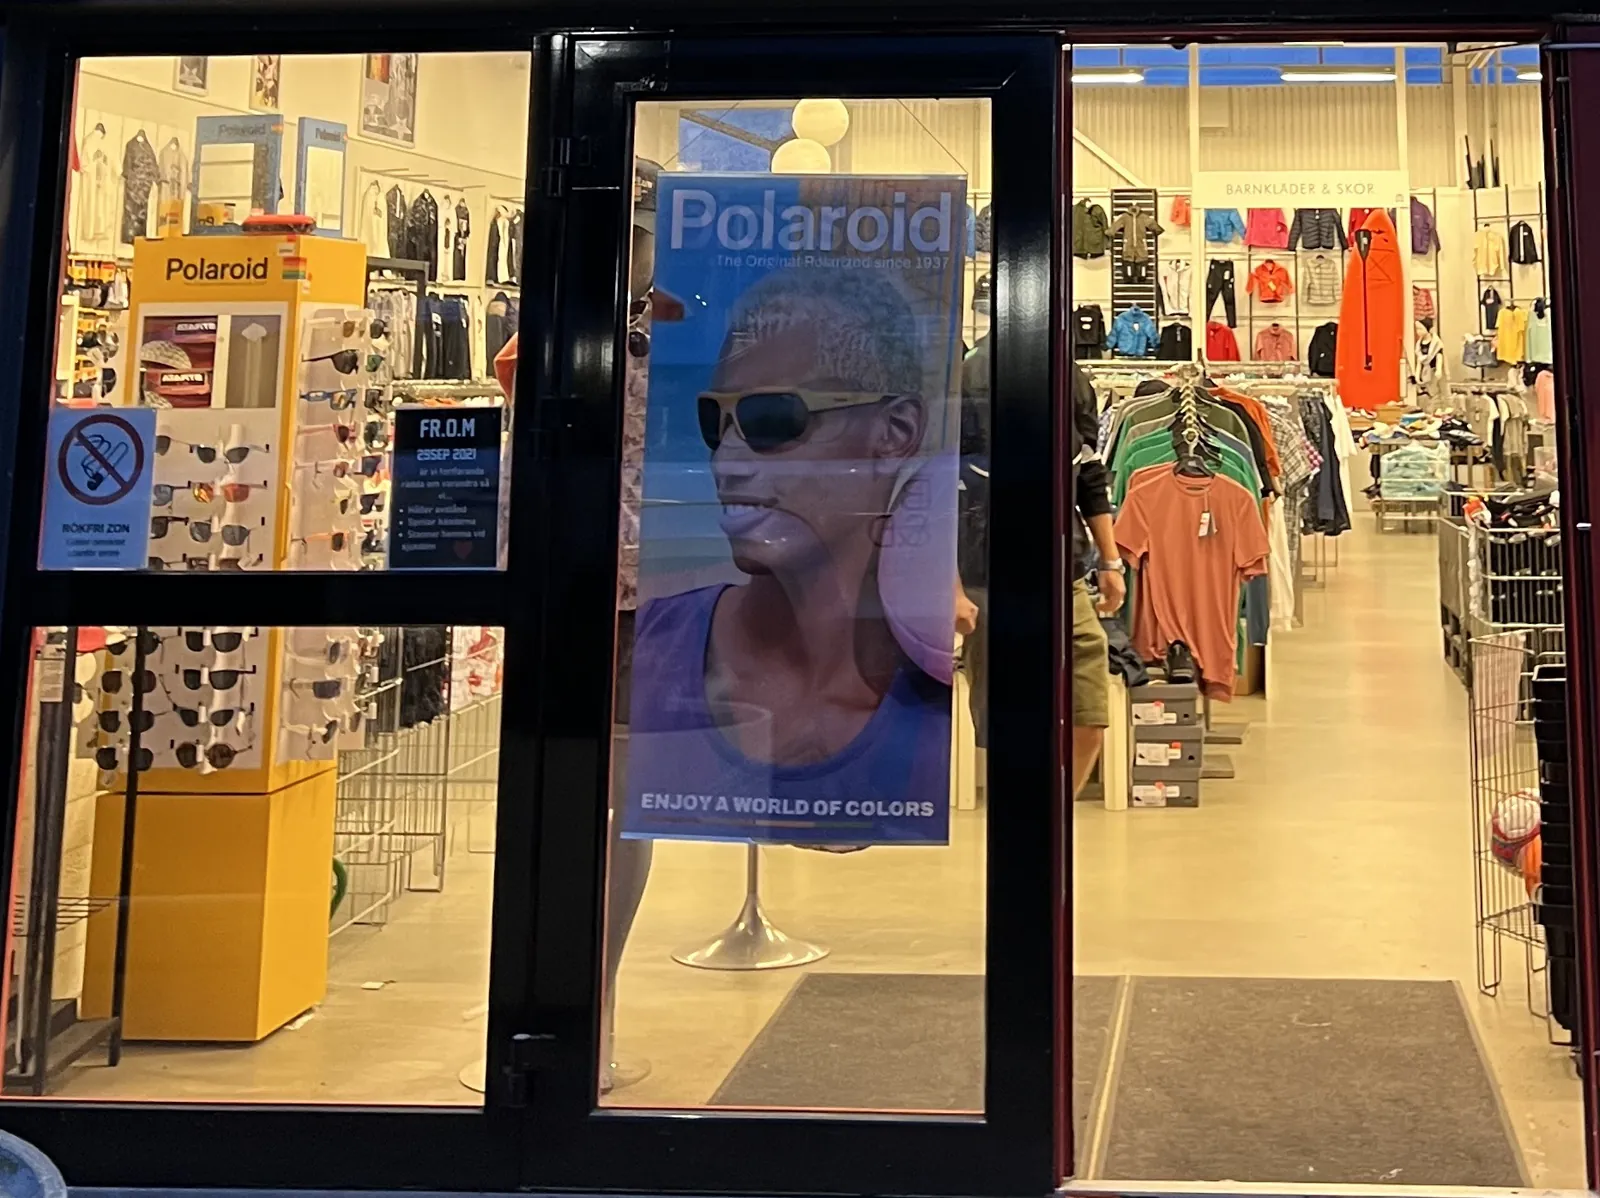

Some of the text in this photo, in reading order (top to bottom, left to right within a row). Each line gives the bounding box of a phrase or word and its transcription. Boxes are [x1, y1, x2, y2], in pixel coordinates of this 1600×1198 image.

[1321, 183, 1331, 195] &
[670, 189, 952, 251] Polaroid
[166, 257, 269, 281] Polaroid
[717, 254, 741, 267] The
[746, 254, 799, 269] Original
[875, 256, 911, 269] since
[915, 256, 949, 270] 1937
[420, 418, 476, 438] FR.O.M
[106, 523, 130, 534] ZON
[641, 793, 934, 817] ENJOY A WORLD OF COLORS
